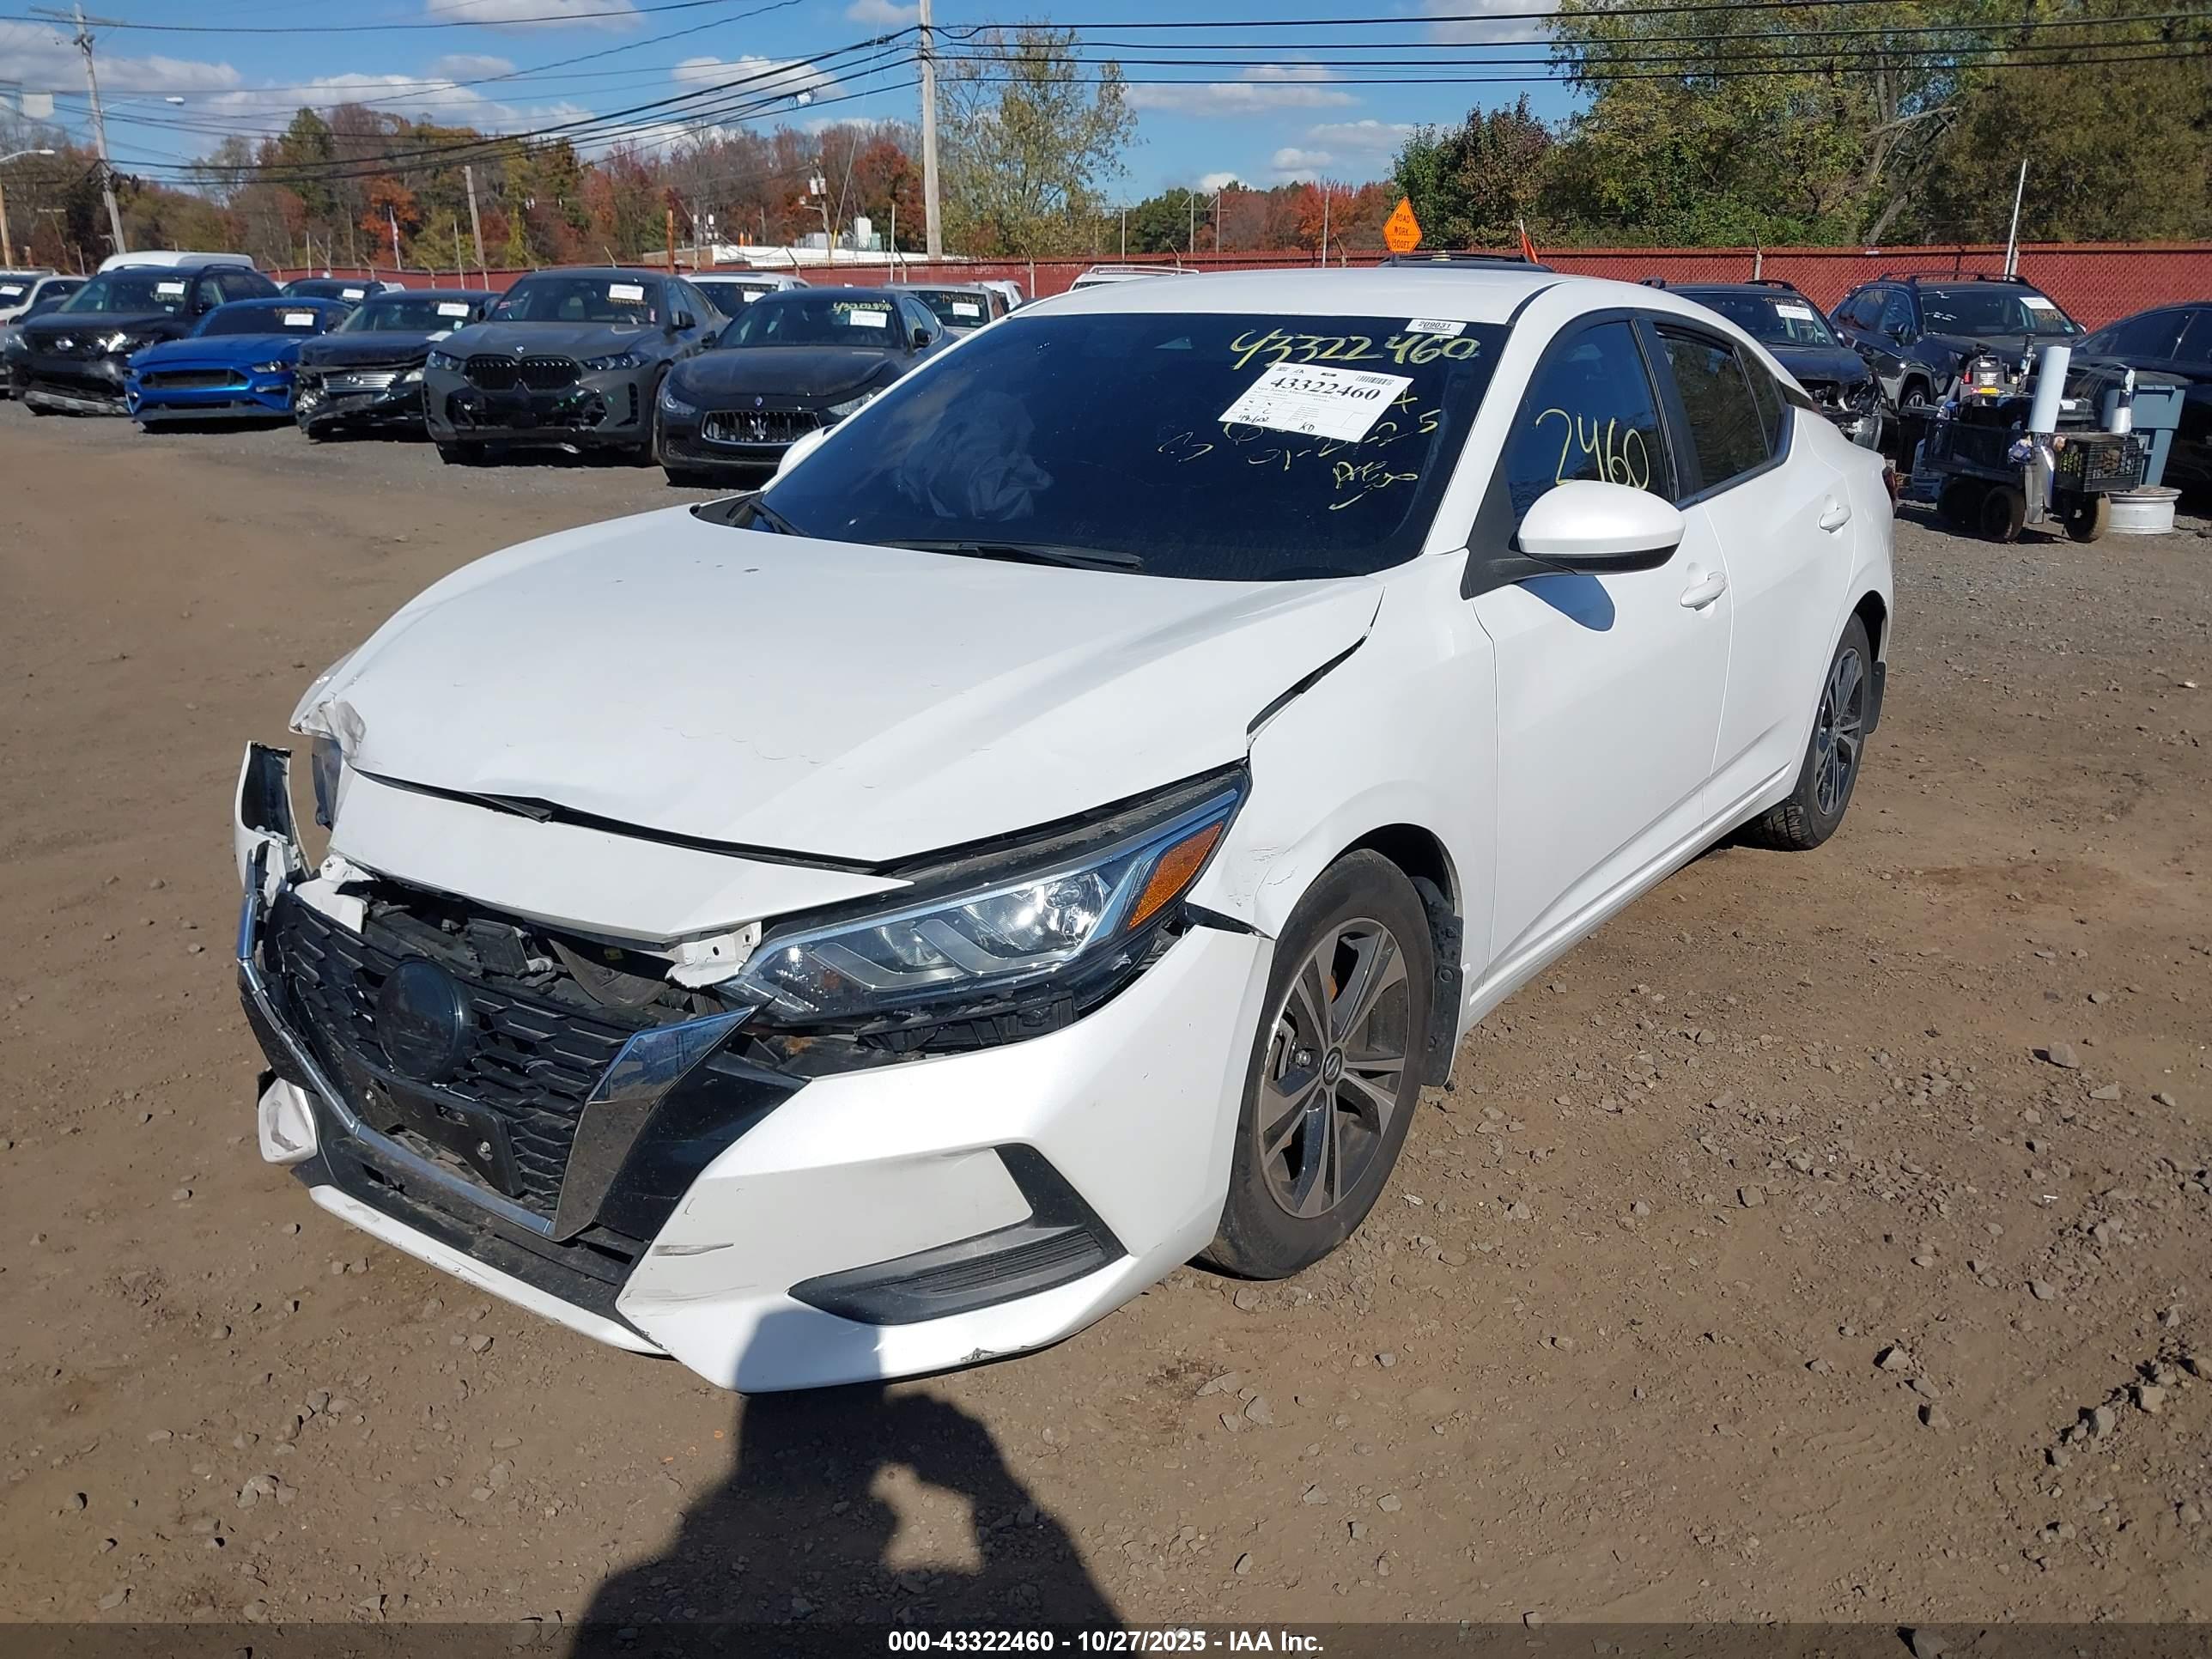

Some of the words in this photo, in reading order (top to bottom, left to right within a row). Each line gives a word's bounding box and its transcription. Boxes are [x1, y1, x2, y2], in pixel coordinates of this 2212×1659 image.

[1396, 213, 1410, 223] ROAD
[1395, 226, 1409, 235] WORK
[1270, 376, 1382, 402] 43322460
[1535, 408, 1650, 489] 2460
